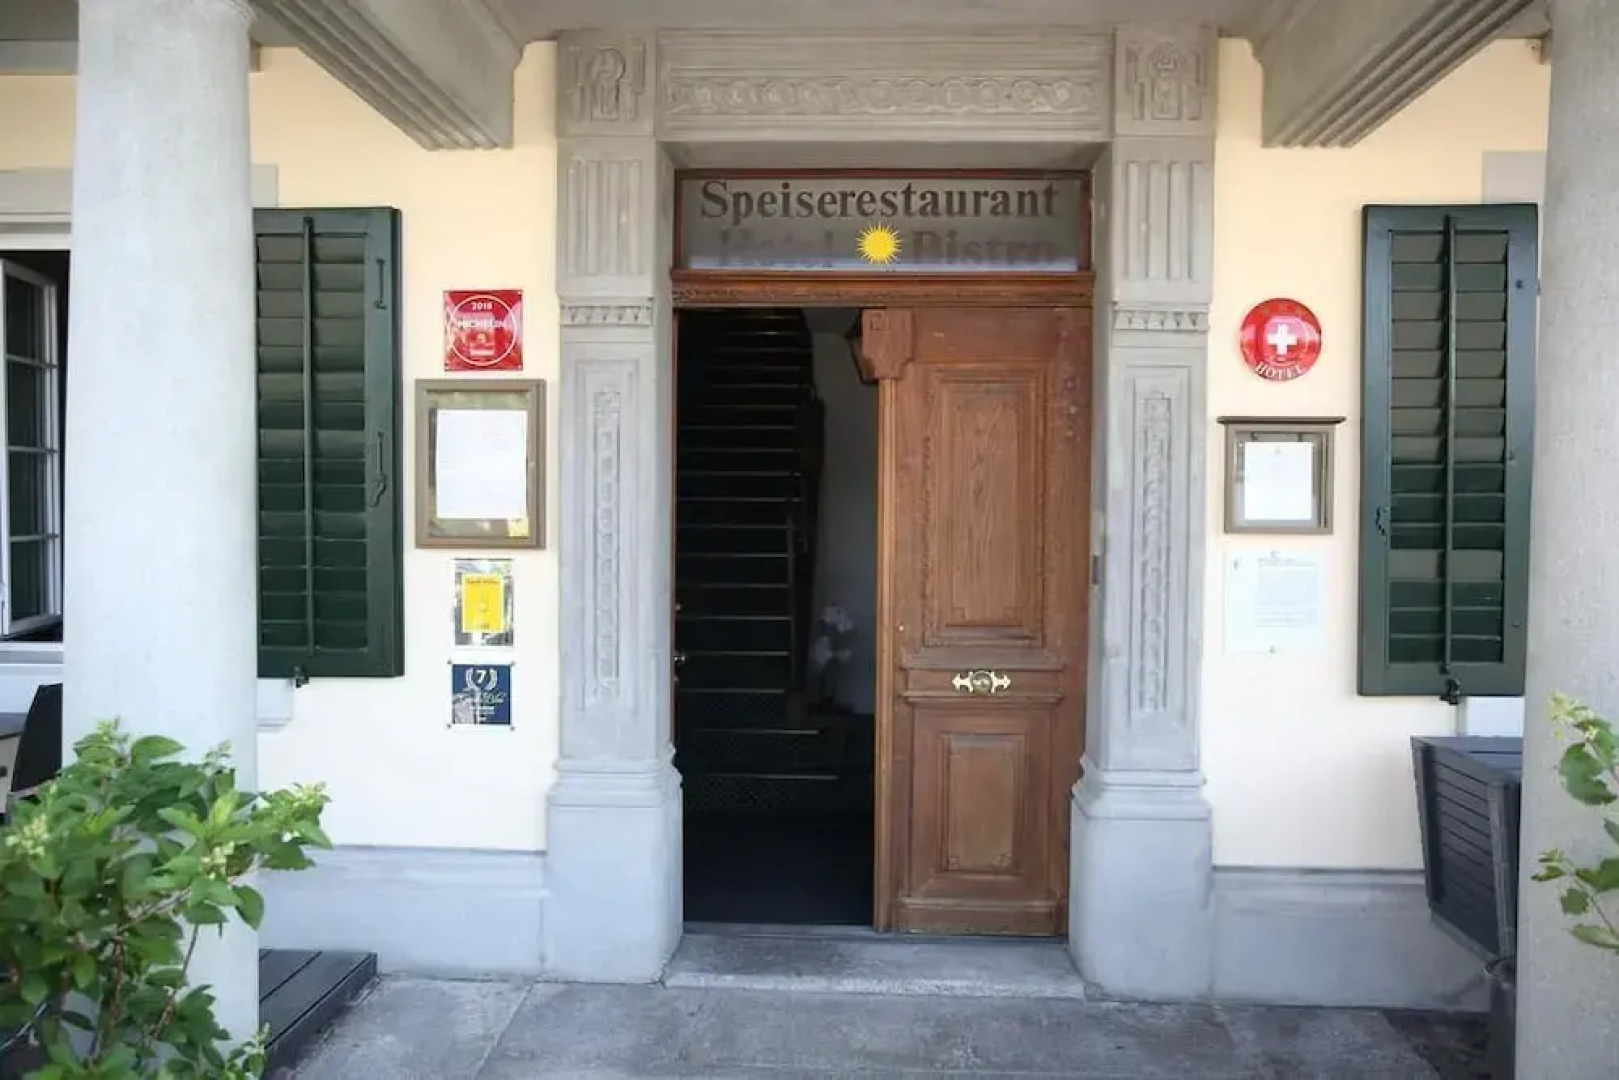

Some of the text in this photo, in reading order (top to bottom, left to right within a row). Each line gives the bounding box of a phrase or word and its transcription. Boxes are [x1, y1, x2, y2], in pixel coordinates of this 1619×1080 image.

[700, 179, 1059, 225] Speiserestaurant
[1255, 360, 1304, 380] HOTEL
[476, 669, 487, 684] 7
